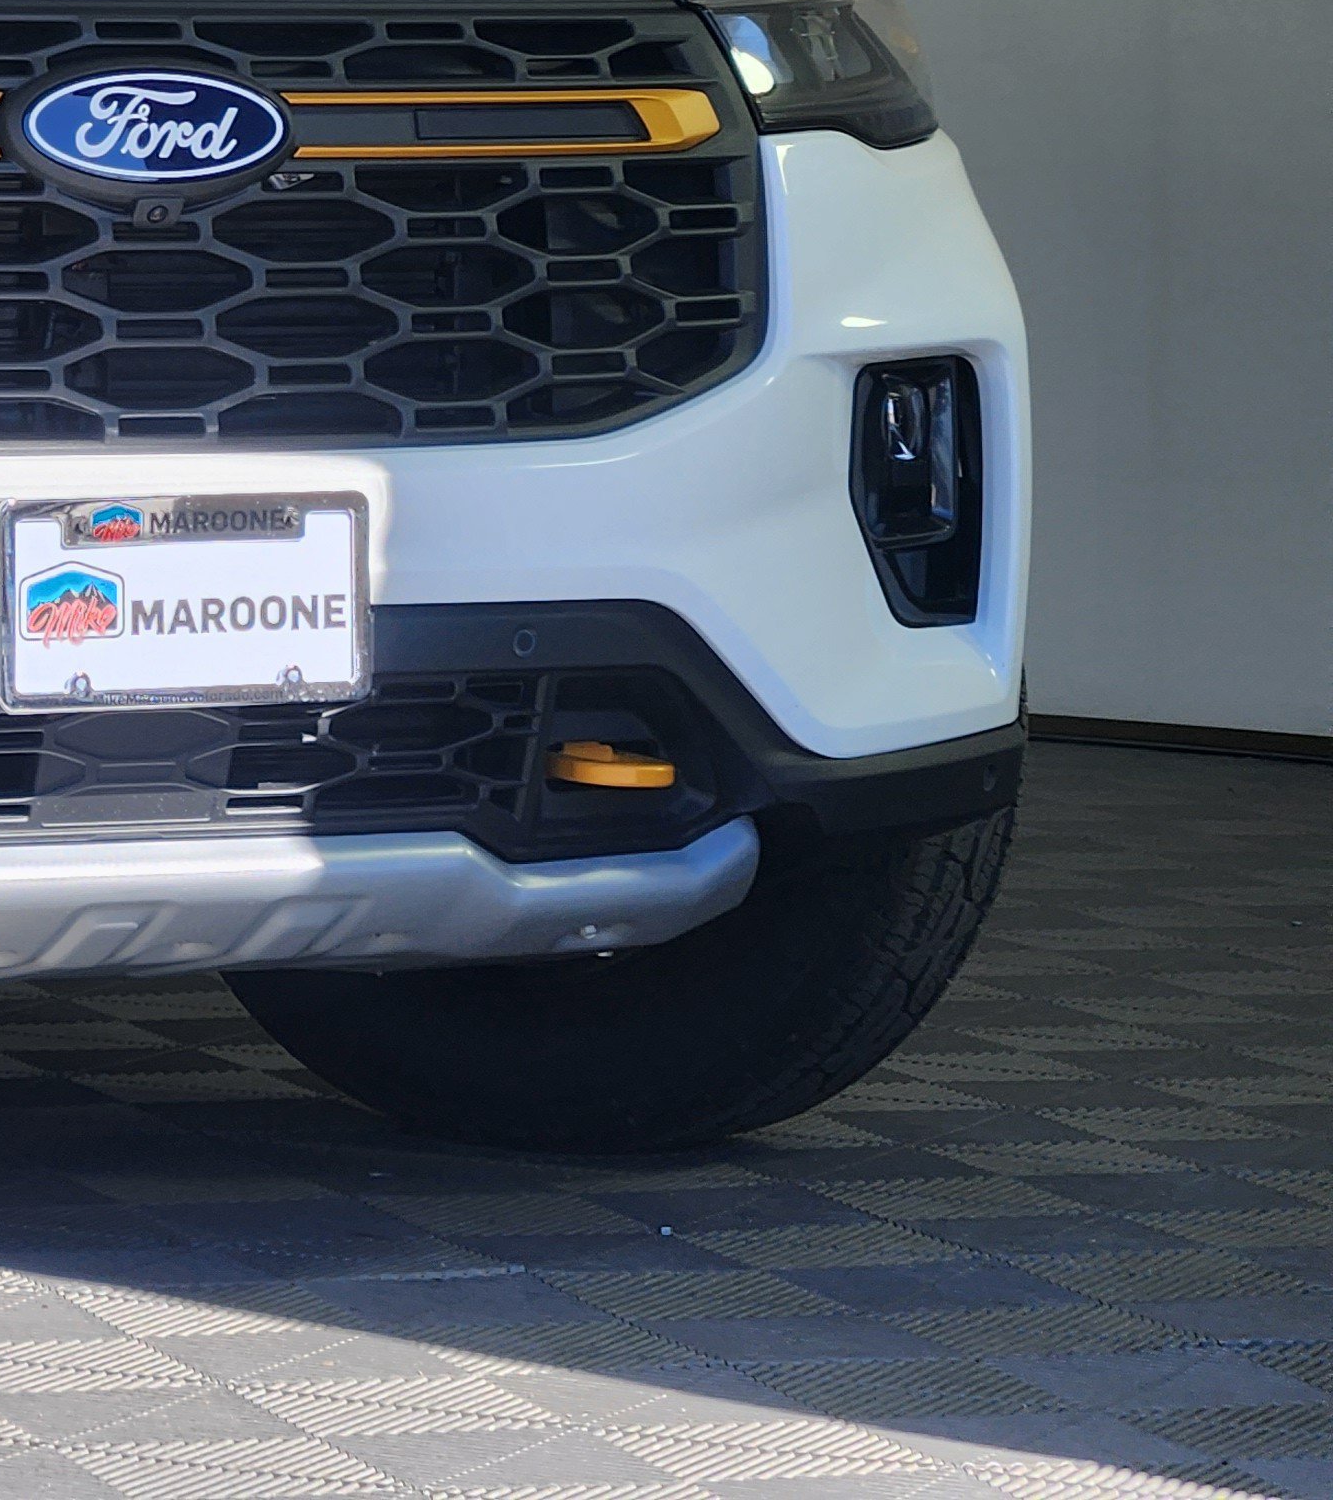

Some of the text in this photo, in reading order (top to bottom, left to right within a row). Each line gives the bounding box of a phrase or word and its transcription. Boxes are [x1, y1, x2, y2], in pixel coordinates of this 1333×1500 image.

[75, 86, 239, 160] Ford
[149, 509, 287, 534] MAROONE
[27, 594, 346, 649] Mike MAROONE
